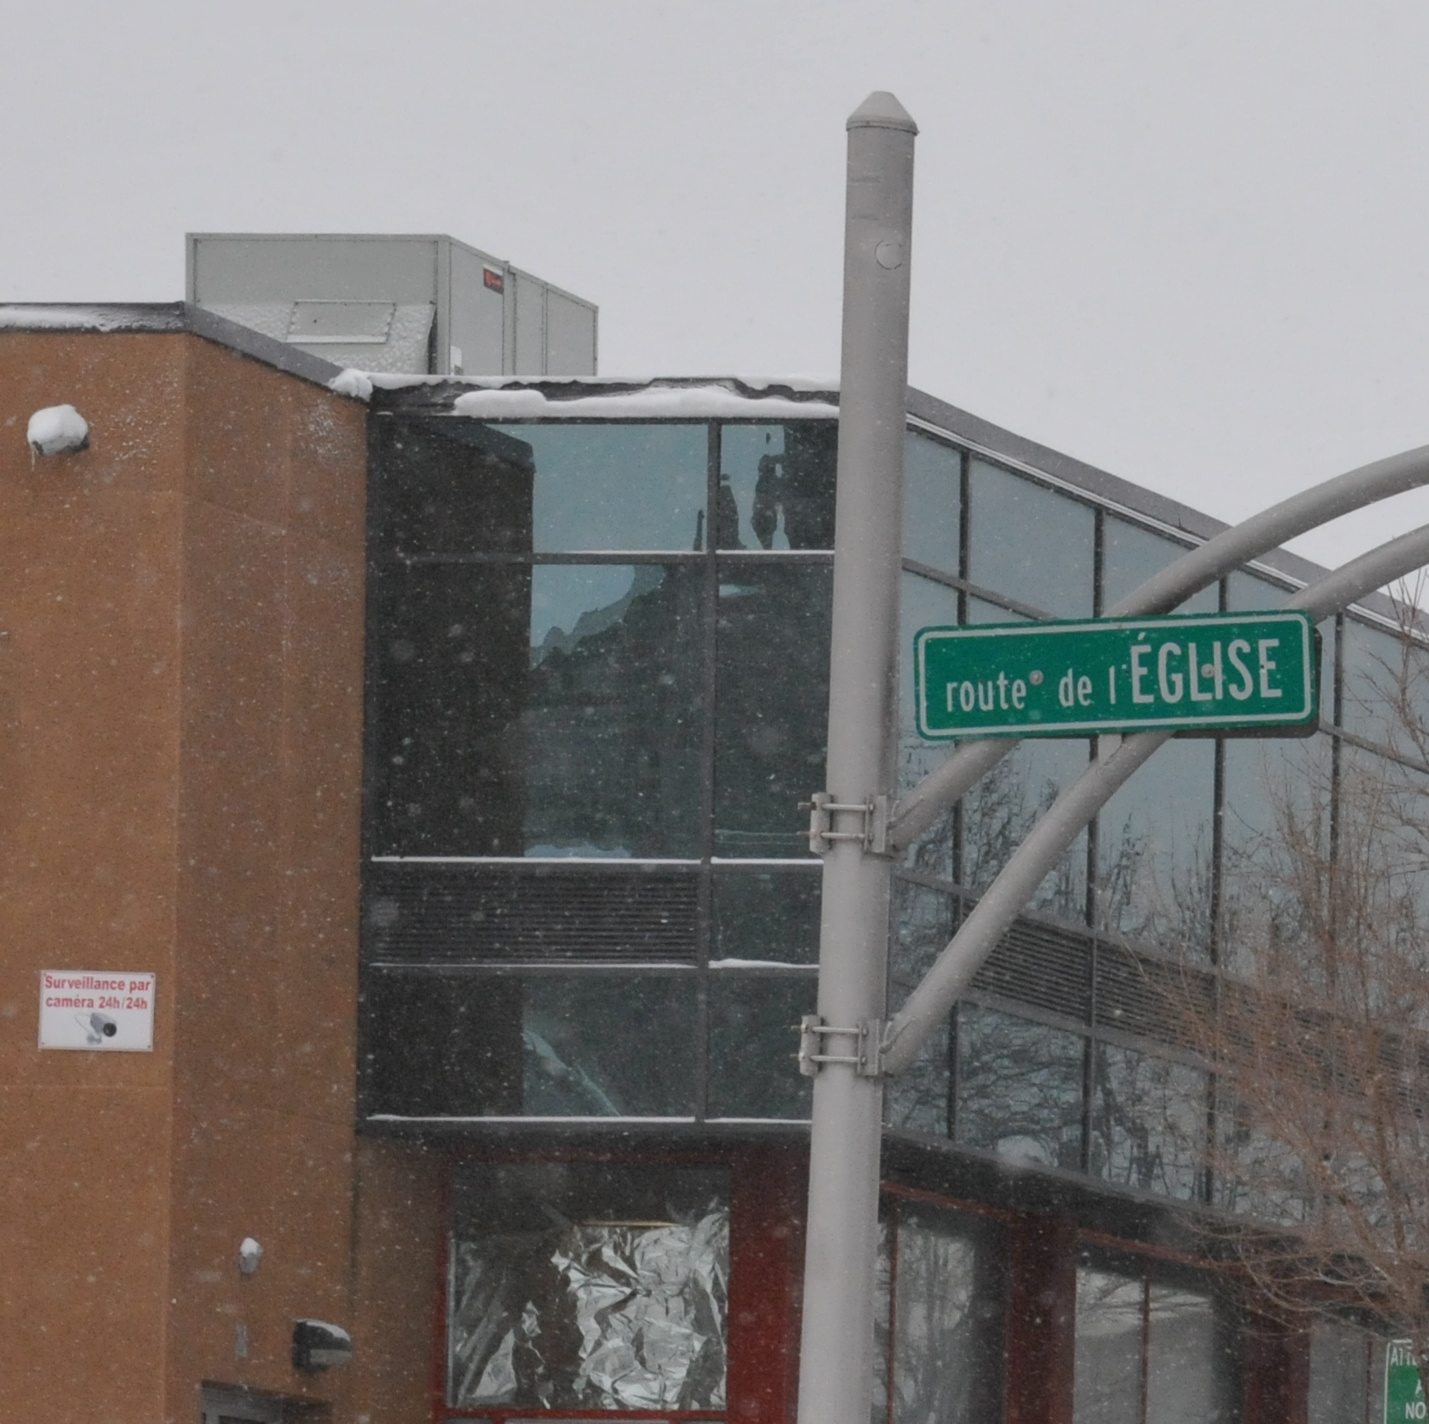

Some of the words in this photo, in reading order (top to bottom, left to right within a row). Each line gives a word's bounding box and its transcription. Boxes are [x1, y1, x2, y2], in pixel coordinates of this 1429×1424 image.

[945, 670, 1027, 712] route
[1057, 667, 1093, 708] de
[45, 975, 125, 991] Surveillance
[129, 980, 151, 994] par
[45, 994, 94, 1009] caméra
